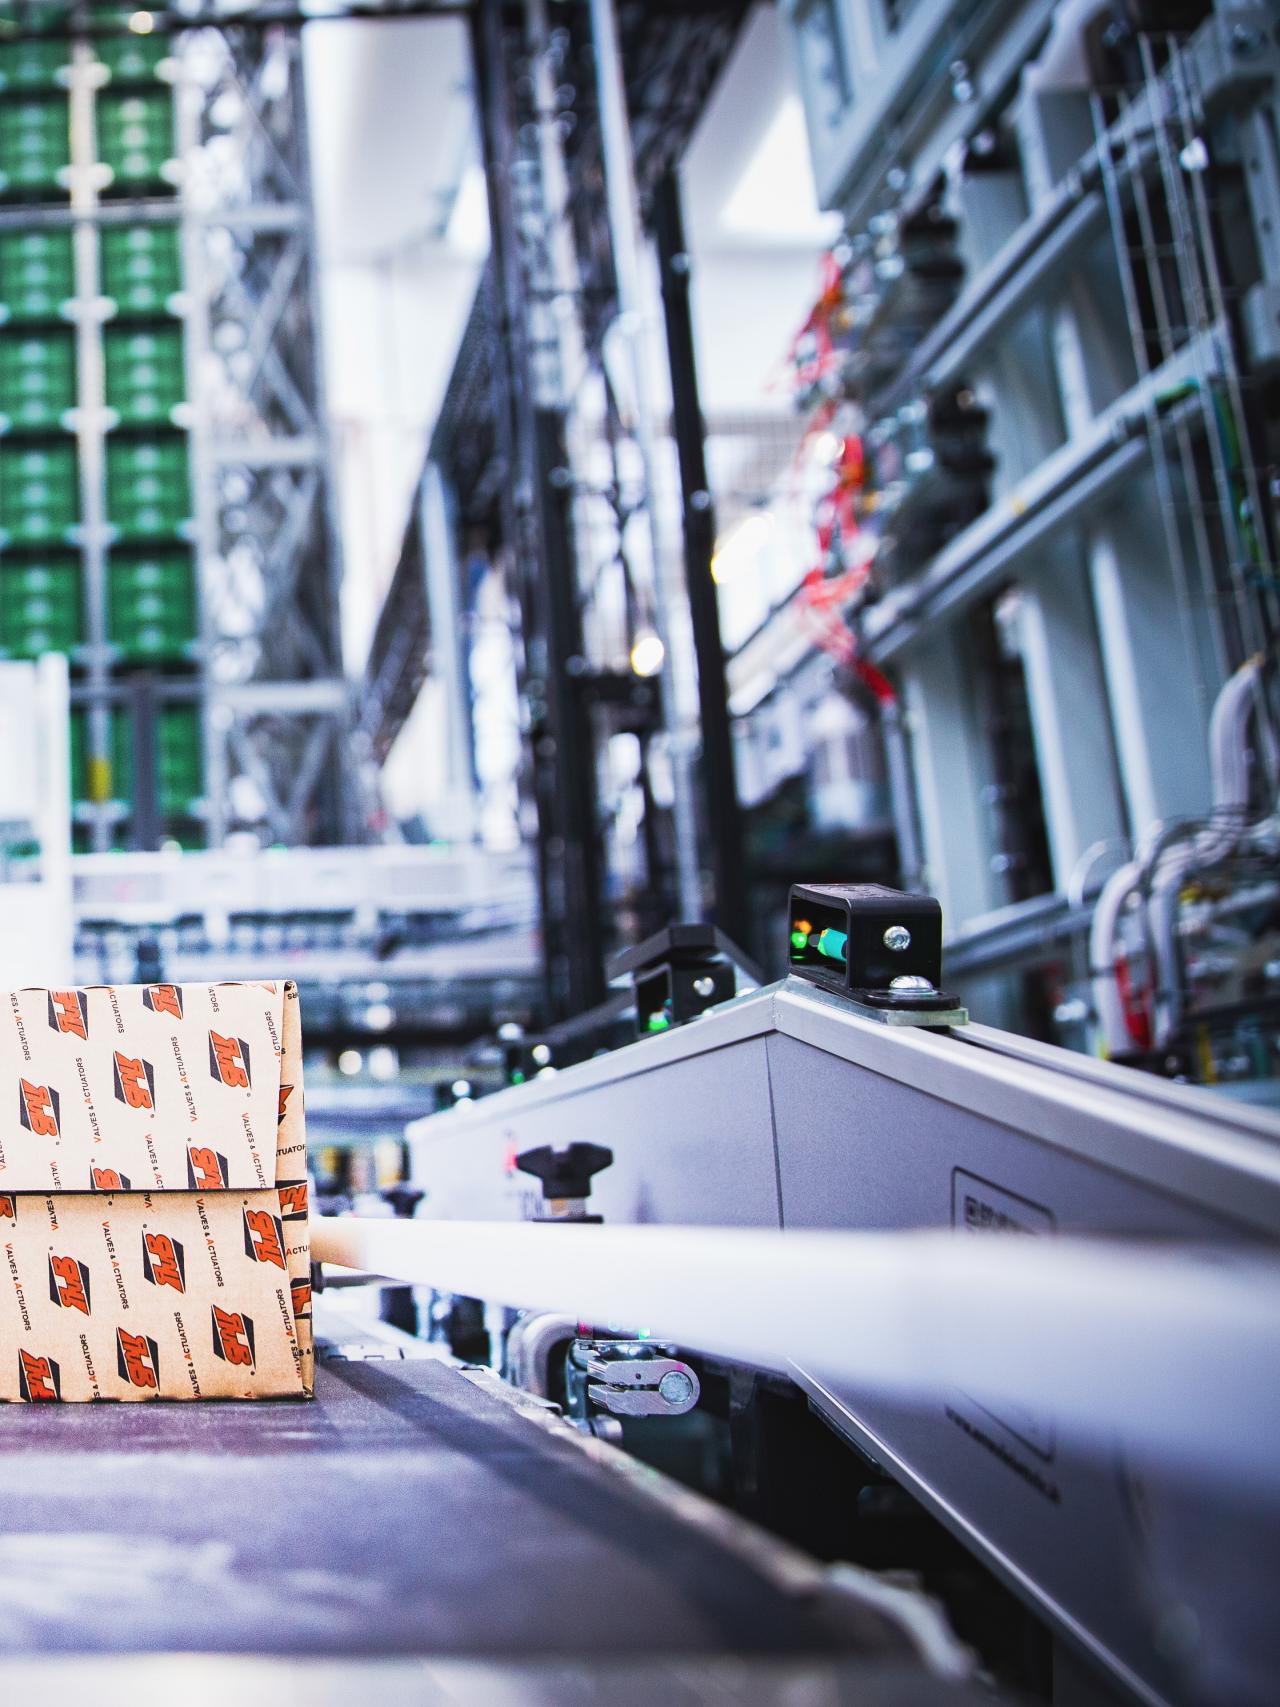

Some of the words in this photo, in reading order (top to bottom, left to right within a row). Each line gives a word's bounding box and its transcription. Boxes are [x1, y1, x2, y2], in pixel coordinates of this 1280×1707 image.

[15, 1015, 31, 1061] ACTUATORS
[171, 1036, 187, 1082] ACTUATORS
[75, 1057, 92, 1104] ACTUATORS
[89, 1112, 101, 1143] VALVES
[185, 1091, 198, 1122] VALVES
[145, 1134, 158, 1164] VALVES
[242, 1112, 255, 1143] VALVES
[251, 1152, 266, 1189] ACTUAT
[47, 1200, 59, 1231] VALVES
[102, 1221, 115, 1253] VALVES
[111, 1261, 129, 1310] ACTUATORS
[195, 1198, 209, 1230] VALVES
[206, 1238, 224, 1288] ACTUATORS
[4, 1243, 18, 1275] VALVES
[14, 1282, 32, 1331] ACTUATORS
[174, 1312, 192, 1360] ACTUATORS
[276, 1289, 294, 1337] ACTUATORS
[80, 1334, 97, 1382] ACTUATORS
